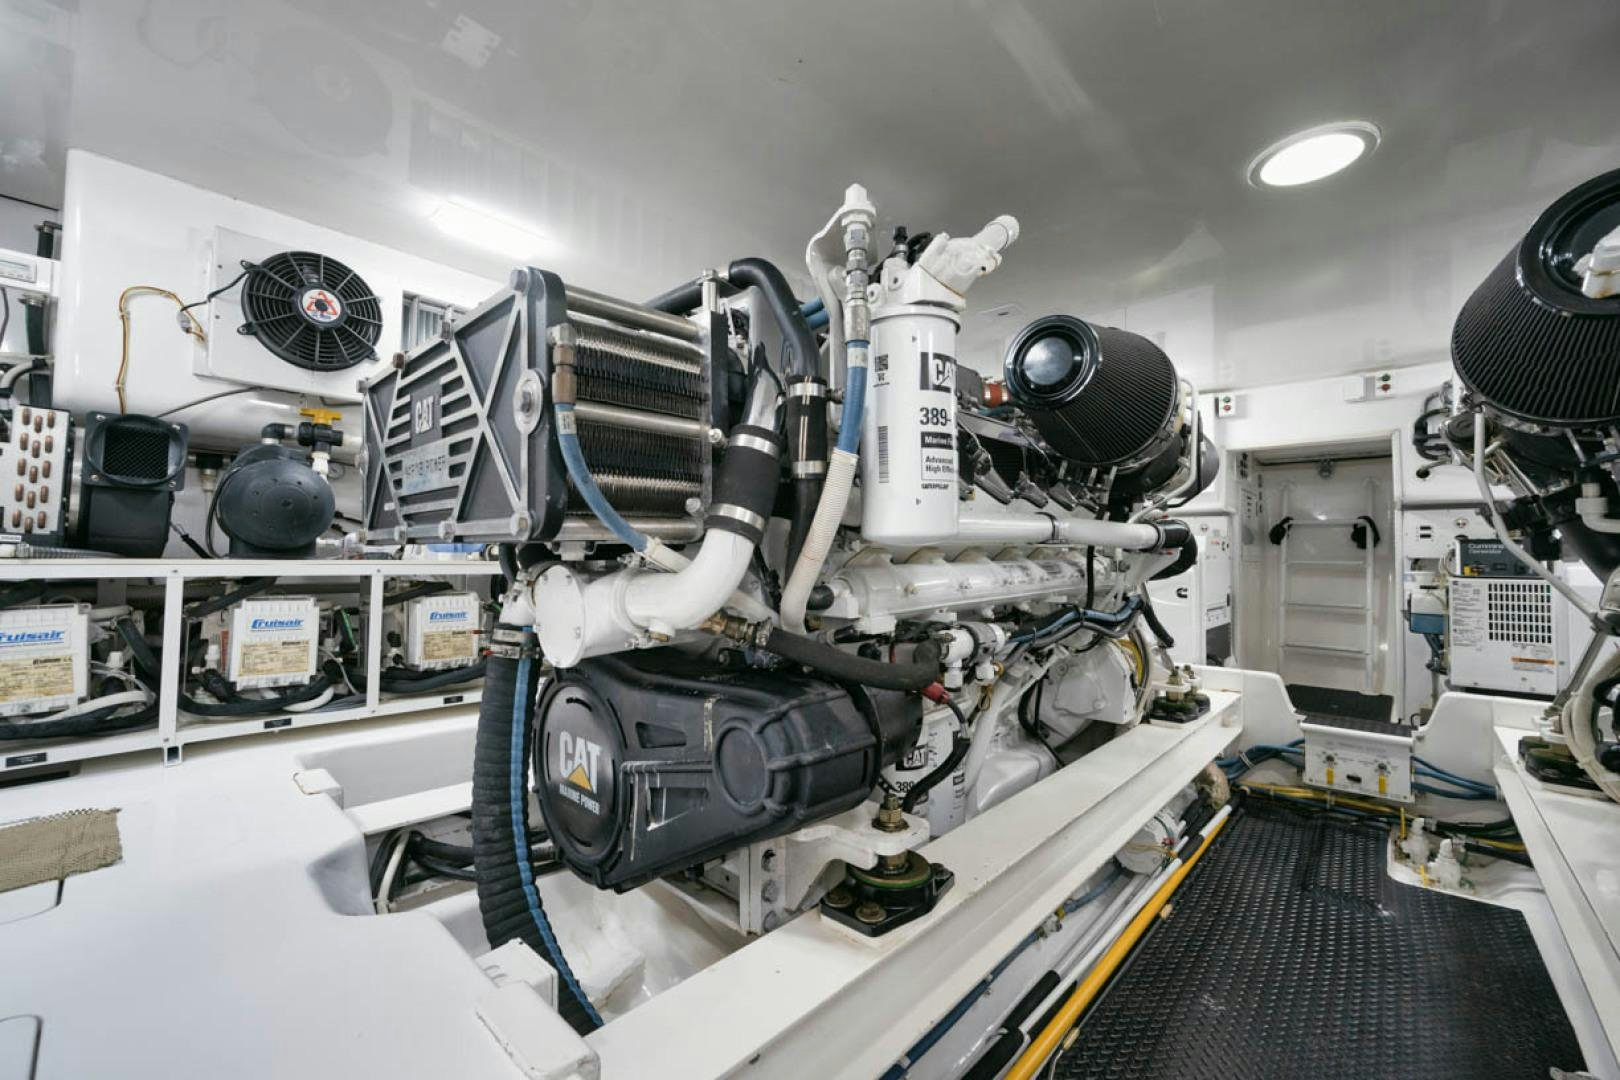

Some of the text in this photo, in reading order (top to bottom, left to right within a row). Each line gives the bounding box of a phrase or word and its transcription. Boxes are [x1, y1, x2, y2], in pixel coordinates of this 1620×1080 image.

[415, 395, 434, 434] CAT
[0, 630, 65, 643] ruisair
[251, 618, 305, 630] Cruisair
[559, 730, 602, 795] CAT
